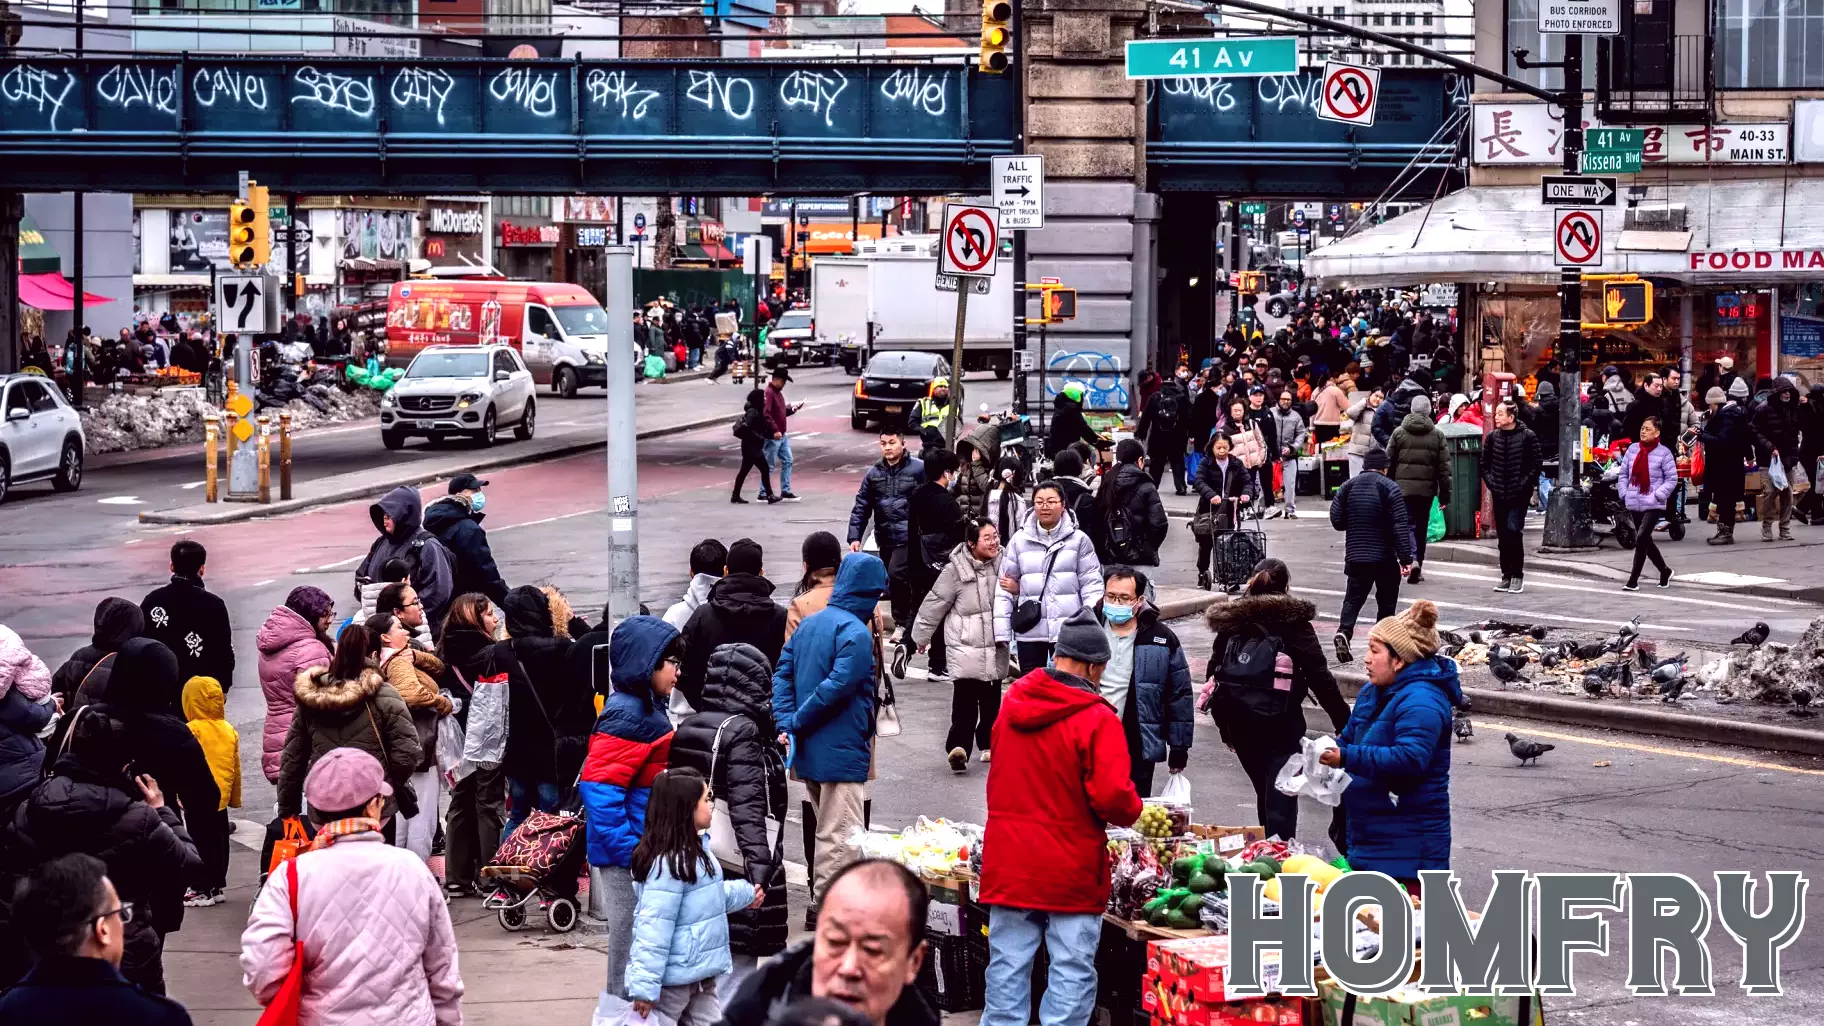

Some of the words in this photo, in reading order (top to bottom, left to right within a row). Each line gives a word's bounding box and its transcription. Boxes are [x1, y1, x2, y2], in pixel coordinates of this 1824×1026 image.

[1550, 6, 1566, 15] BUS
[1568, 6, 1607, 16] CORRIDOR
[1544, 19, 1570, 28] PHOTO
[1572, 20, 1613, 29] ENFORCED
[1168, 47, 1200, 69] 41
[1213, 46, 1254, 68] Av
[1598, 131, 1613, 148] 41
[1619, 133, 1631, 142] Av
[1739, 130, 1775, 142] 40-33
[1582, 154, 1622, 171] Kissena
[1625, 151, 1640, 164] Blvd
[1730, 149, 1764, 160] MAIN
[1767, 149, 1786, 160] ST.
[1007, 161, 1028, 171] ALL
[1552, 185, 1574, 197] ONE
[1583, 186, 1606, 198] WAY
[1245, 205, 1254, 213] 40
[432, 208, 483, 234] McDonald's
[1690, 251, 1773, 270] FOOD
[1782, 250, 1824, 269] MA
[936, 274, 958, 289] GENIE
